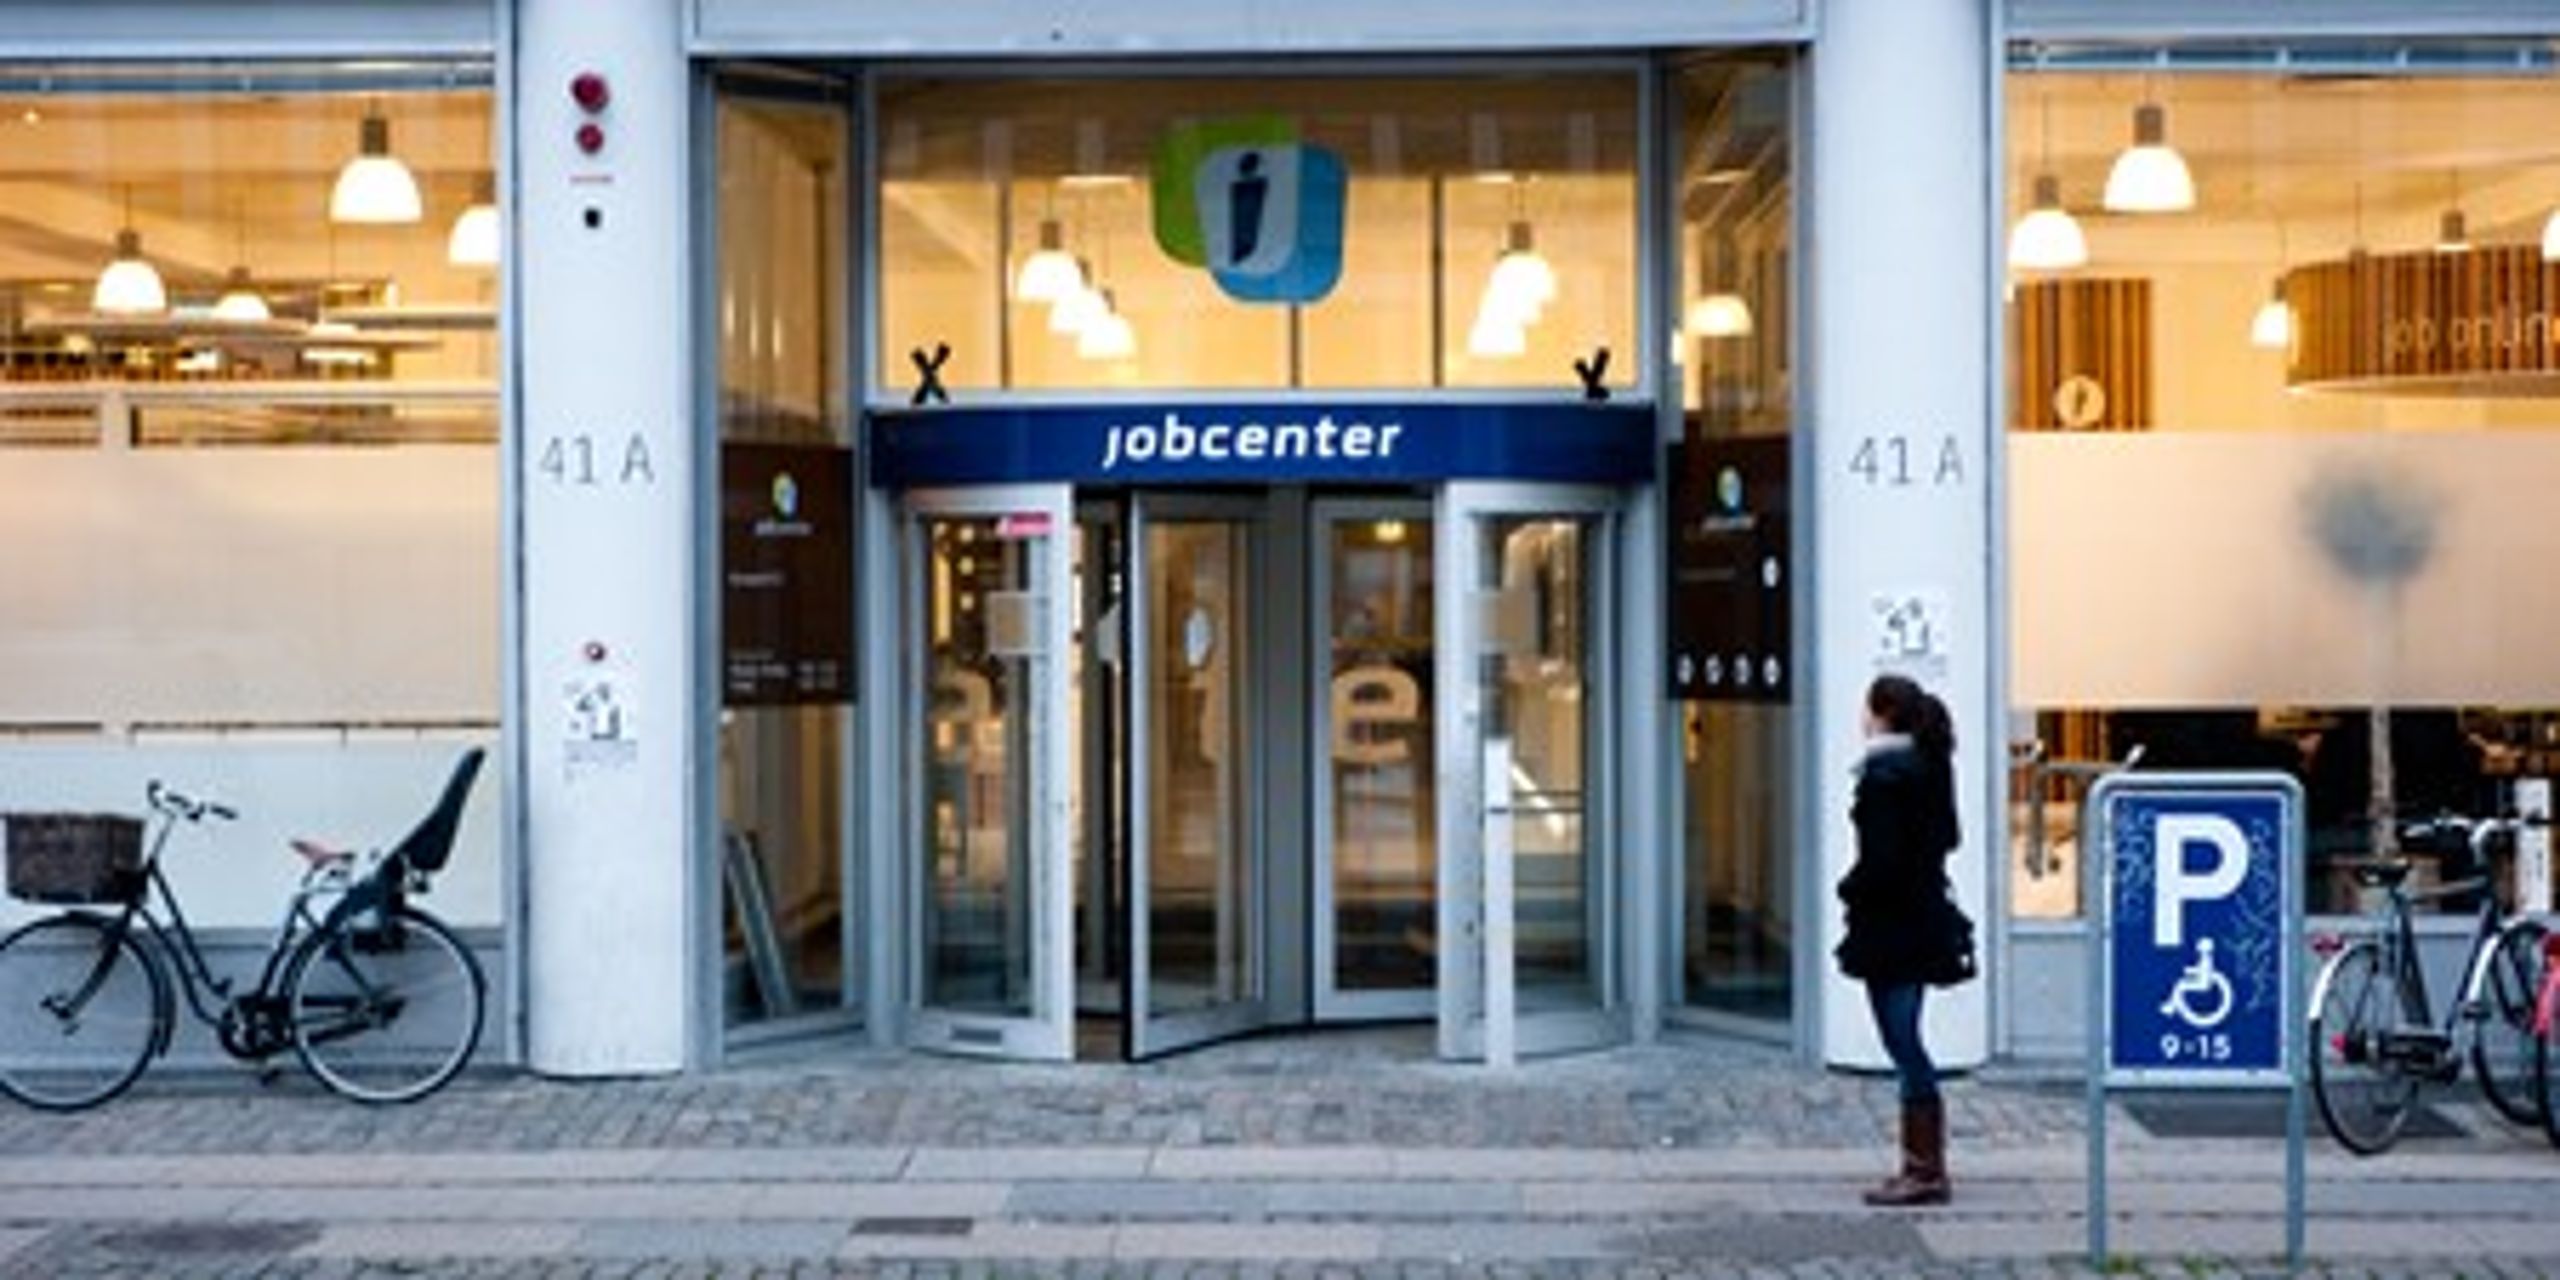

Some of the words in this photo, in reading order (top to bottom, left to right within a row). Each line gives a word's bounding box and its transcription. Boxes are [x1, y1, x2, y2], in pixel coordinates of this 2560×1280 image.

[540, 434, 598, 484] 41
[620, 431, 655, 483] A
[1102, 413, 1402, 469] jobcenter
[1849, 436, 1910, 485] 41
[1934, 432, 1964, 485] A
[2155, 814, 2250, 946] P
[2160, 1033, 2232, 1060] 9-15
